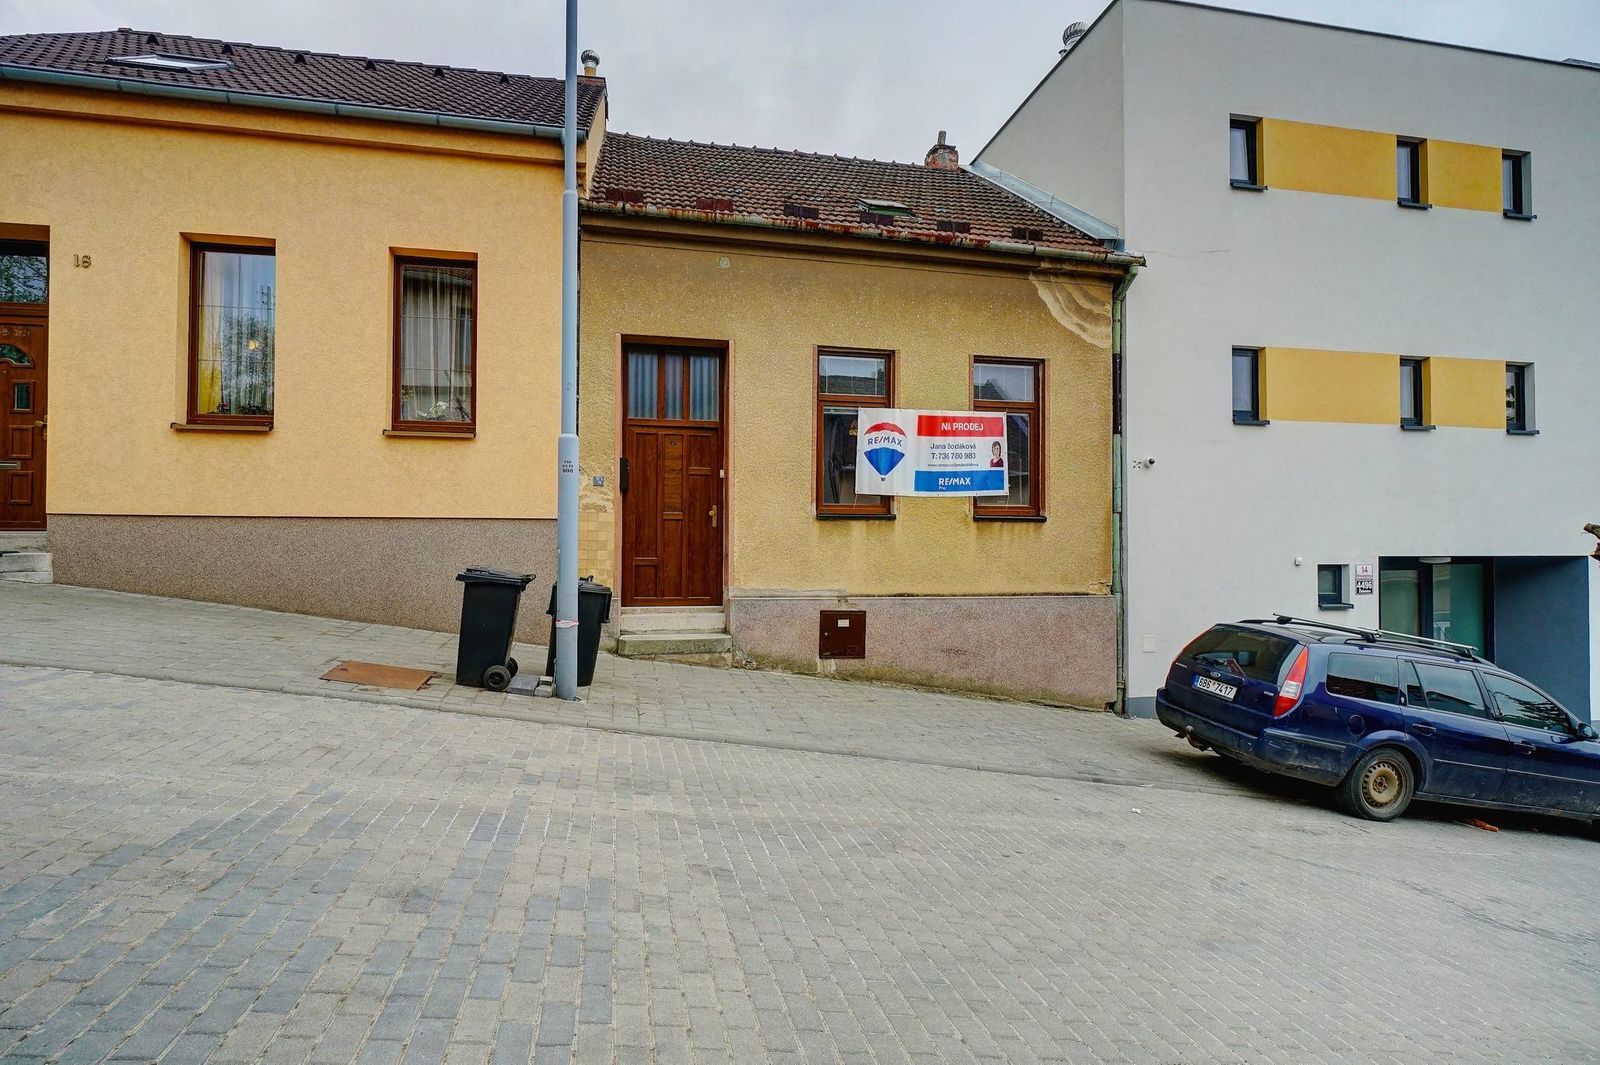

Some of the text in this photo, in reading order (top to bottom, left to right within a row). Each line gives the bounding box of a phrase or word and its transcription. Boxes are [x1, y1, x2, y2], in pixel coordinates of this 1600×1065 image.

[952, 422, 984, 431] PRODEJ
[868, 436, 903, 447] RE/MAX
[964, 452, 976, 460] 983
[938, 477, 971, 486] RE/MAX
[1214, 682, 1233, 696] 7417
